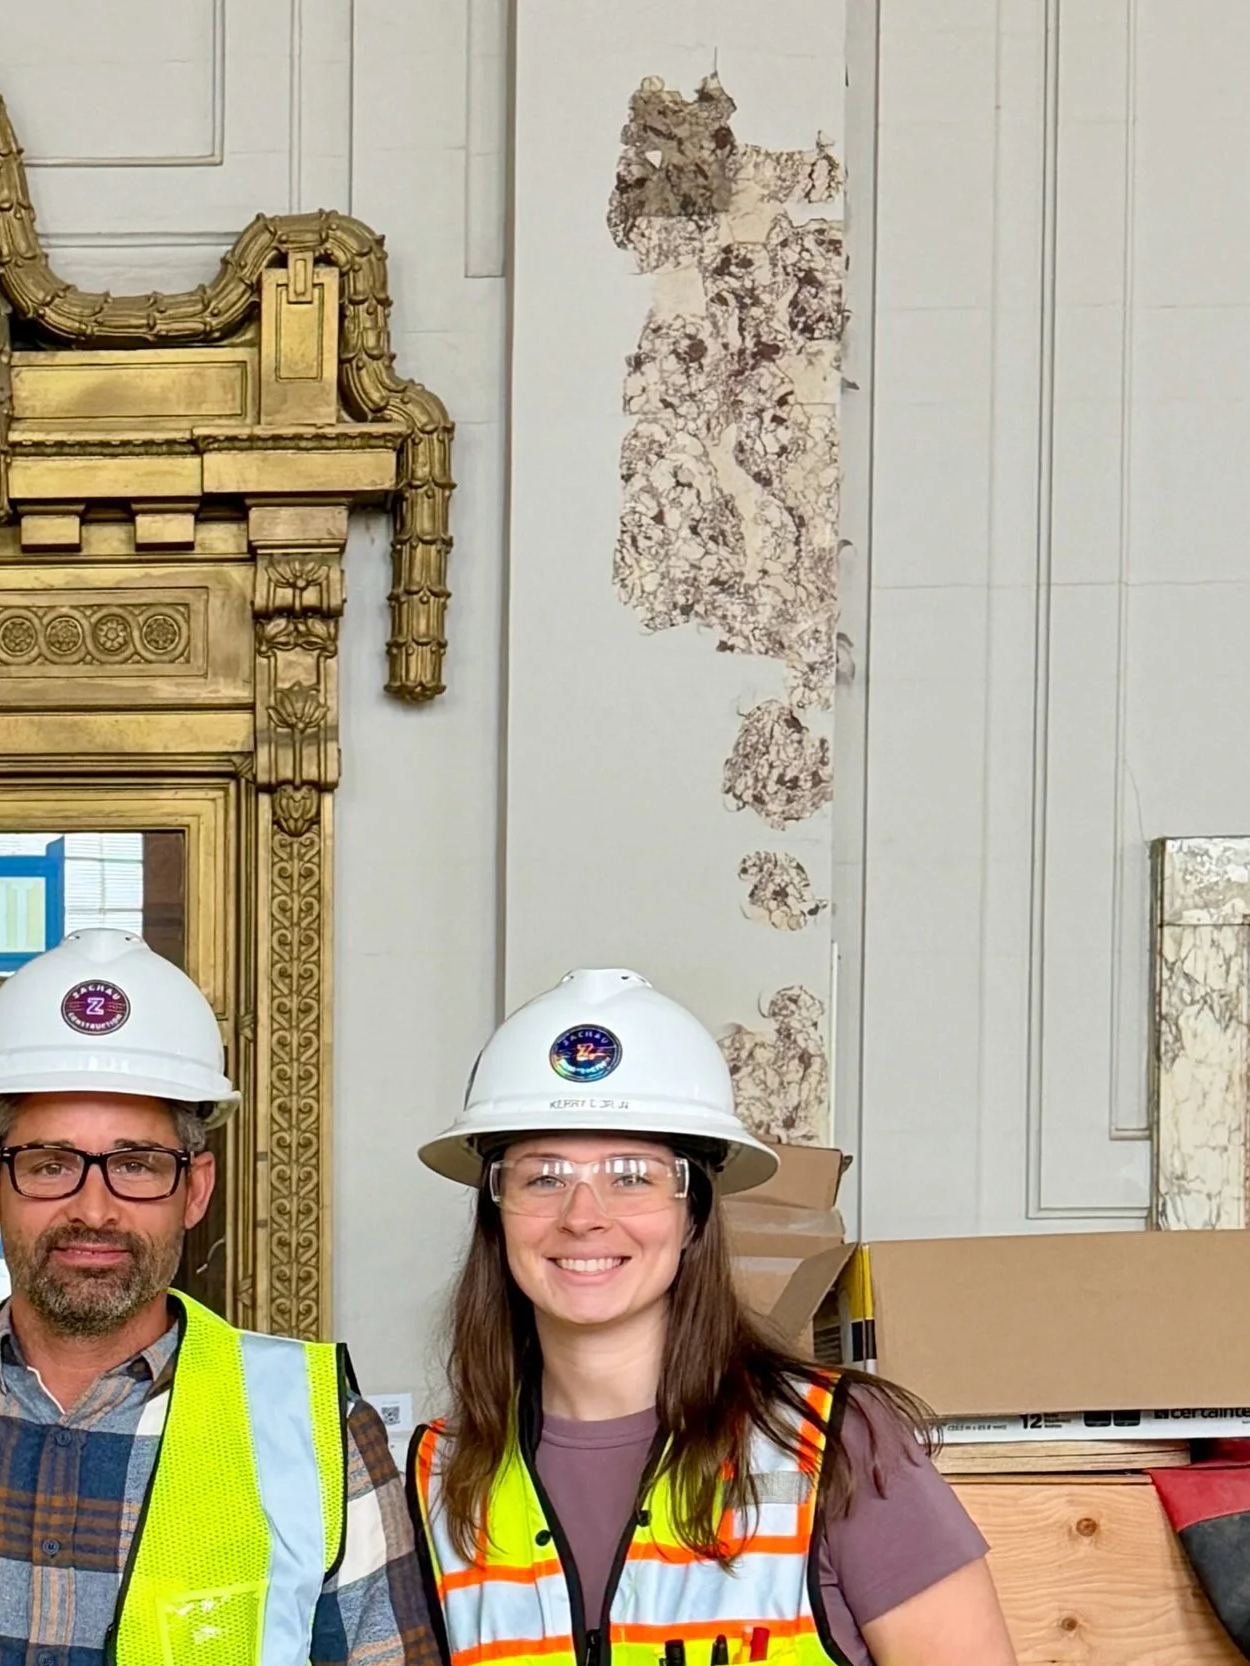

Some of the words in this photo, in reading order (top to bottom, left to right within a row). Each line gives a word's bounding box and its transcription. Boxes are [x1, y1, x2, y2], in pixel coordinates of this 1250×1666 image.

[72, 985, 121, 1000] ZACHAU
[86, 997, 105, 1016] Z
[68, 1012, 123, 1030] CONSTRUCTION
[1020, 1413, 1043, 1429] 12
